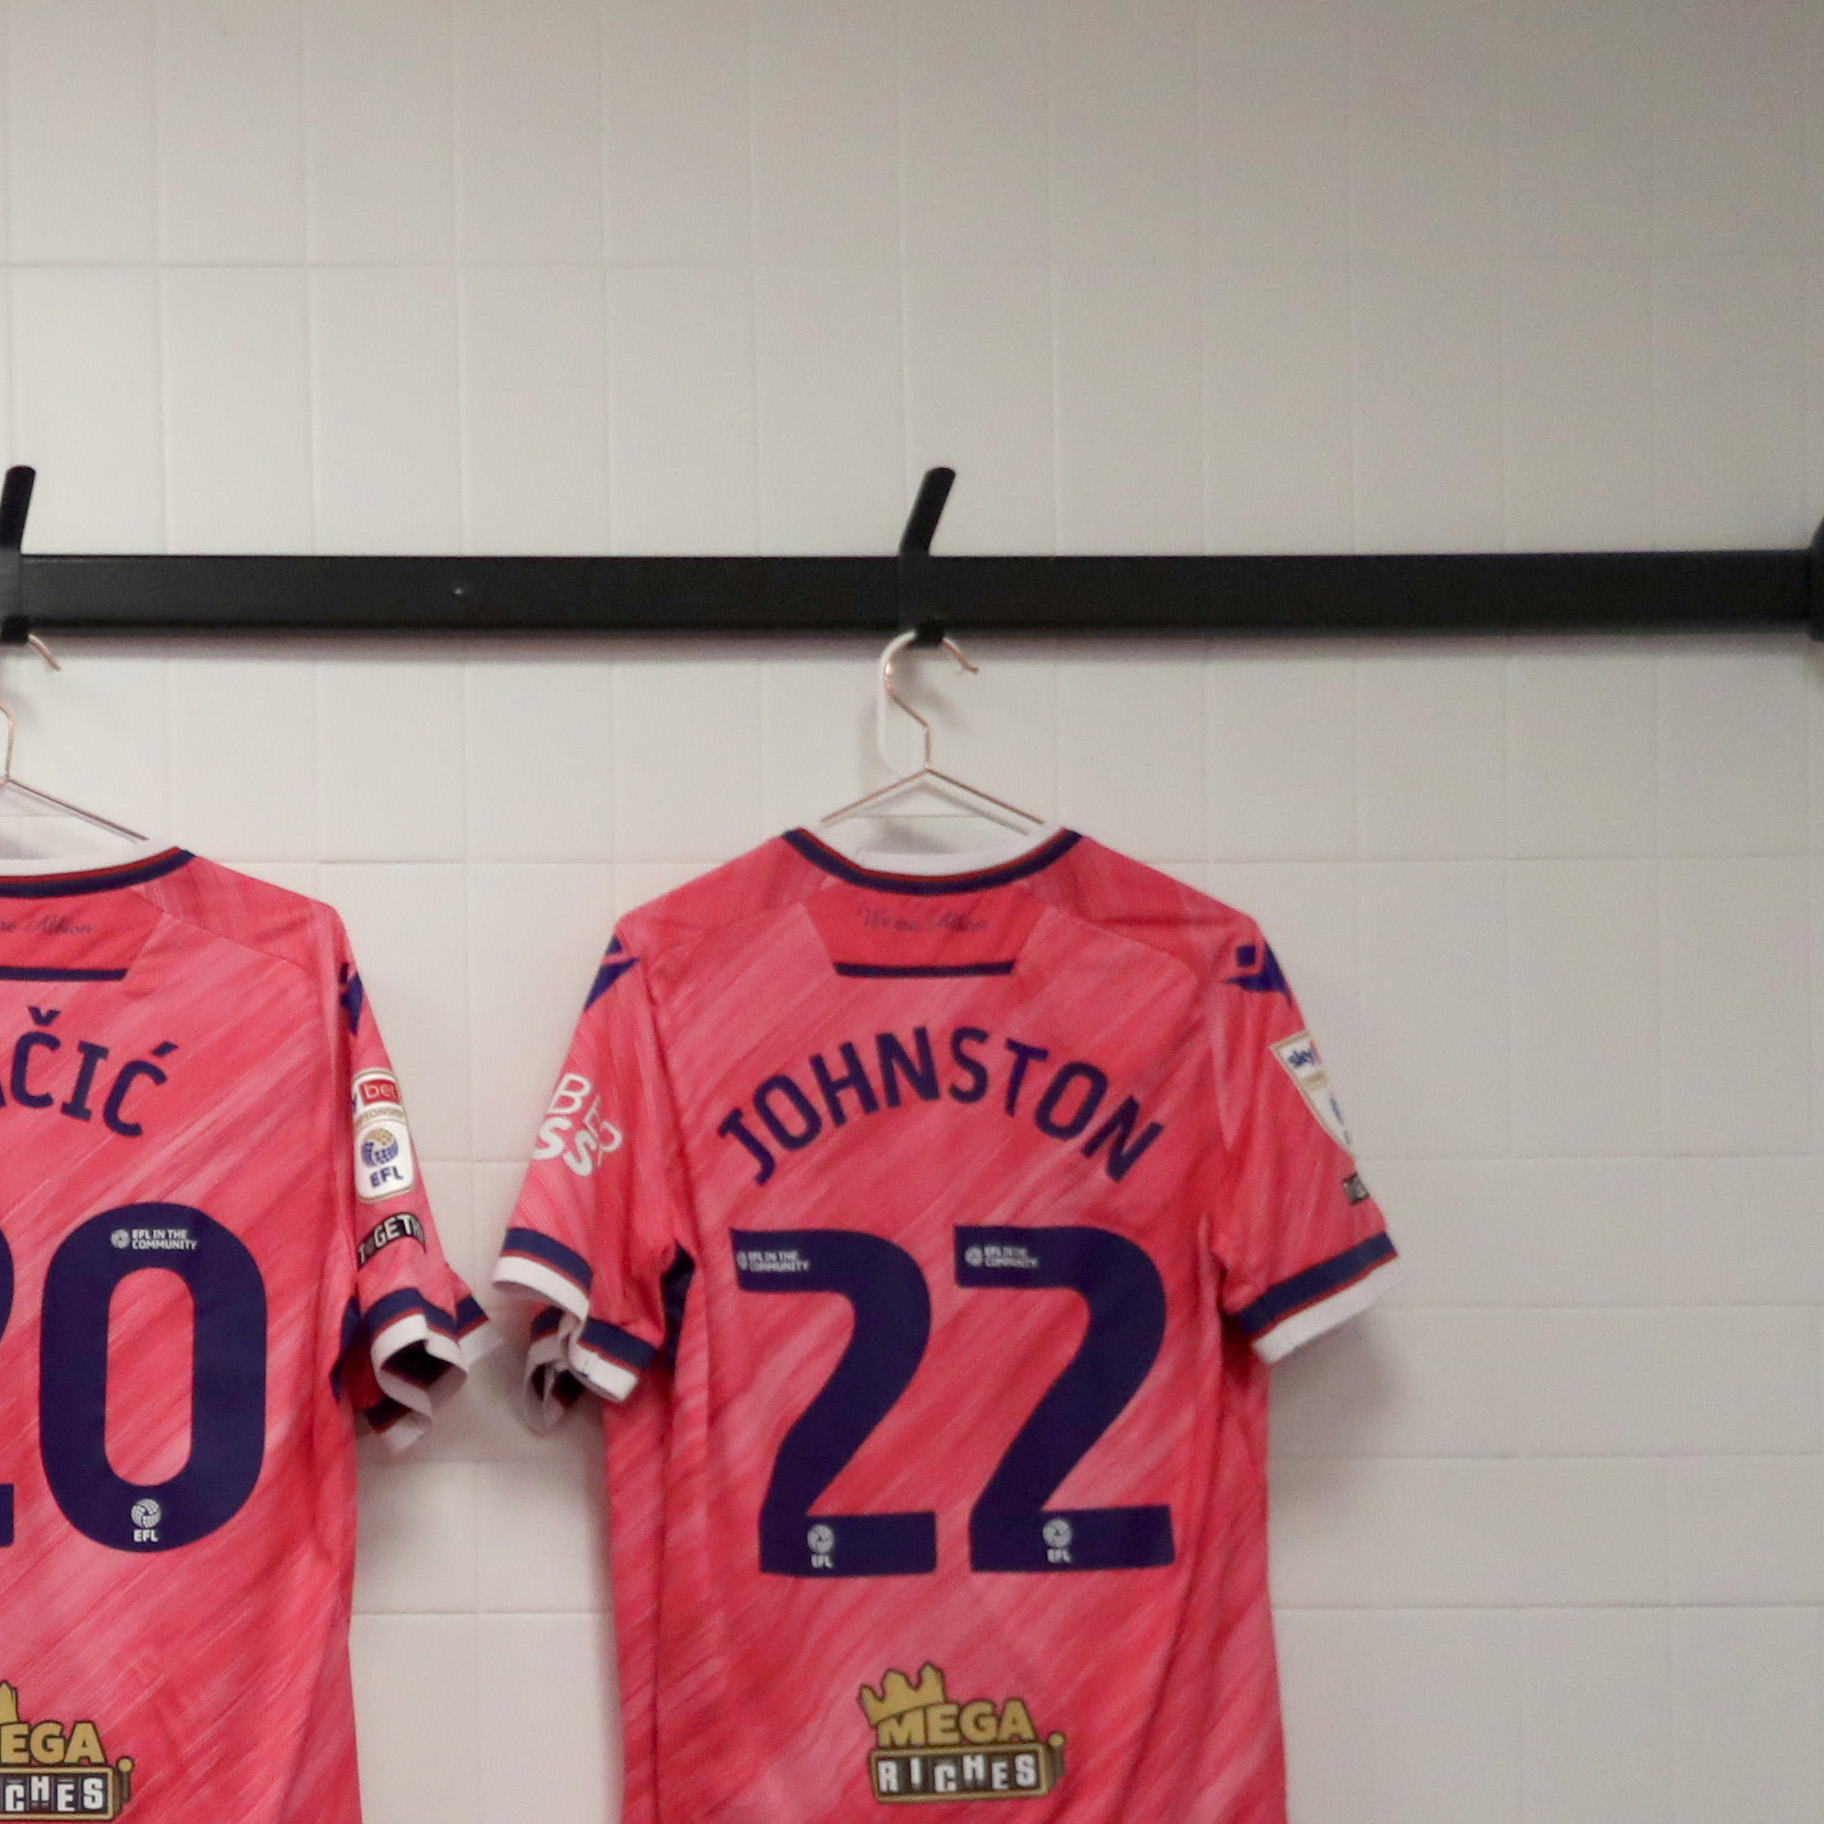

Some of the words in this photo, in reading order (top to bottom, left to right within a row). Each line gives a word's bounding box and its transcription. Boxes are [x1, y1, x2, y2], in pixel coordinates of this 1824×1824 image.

[718, 1026, 1164, 1186] JOHNSTON
[370, 1166, 404, 1189] EFL
[132, 1228, 151, 1239] EFL
[152, 1228, 165, 1239] IN
[167, 1228, 187, 1240] THE
[132, 1238, 197, 1251] COMMUNITY
[730, 1225, 1177, 1579] 22
[132, 1529, 159, 1543] EFL
[876, 1697, 1037, 1747] MEGA
[877, 1754, 1039, 1793] RICHES
